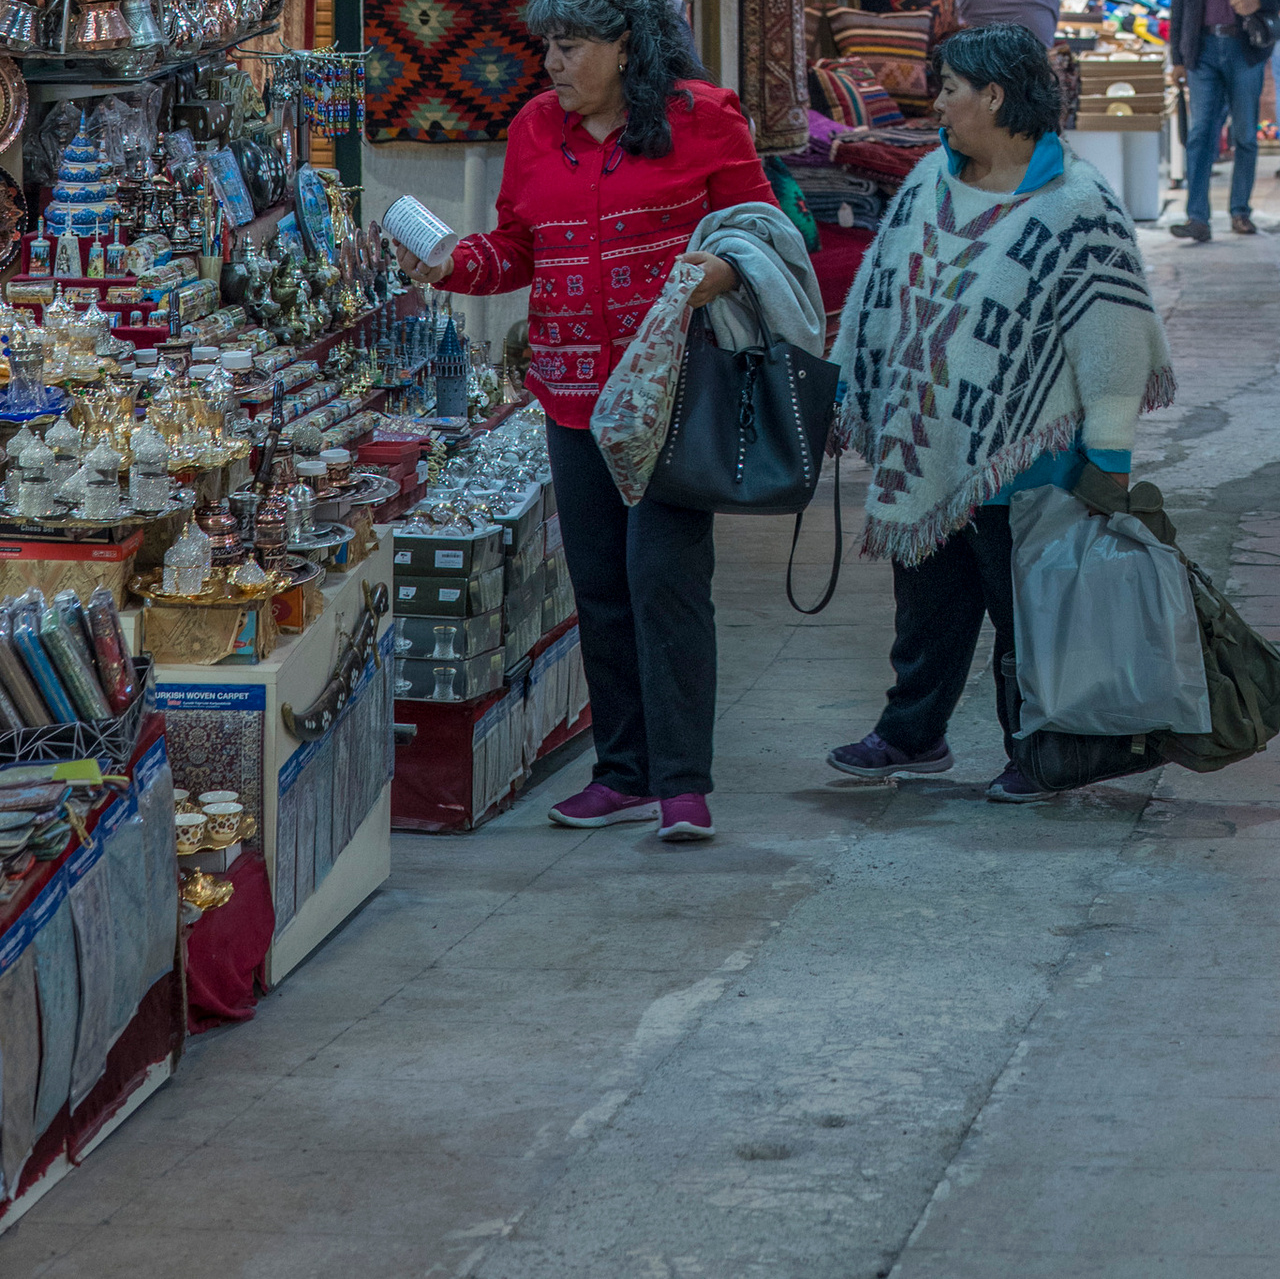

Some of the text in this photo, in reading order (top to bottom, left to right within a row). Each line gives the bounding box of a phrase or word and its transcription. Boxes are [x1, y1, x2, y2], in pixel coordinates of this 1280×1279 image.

[154, 691, 250, 700] URKISH WOVEN CARPET
